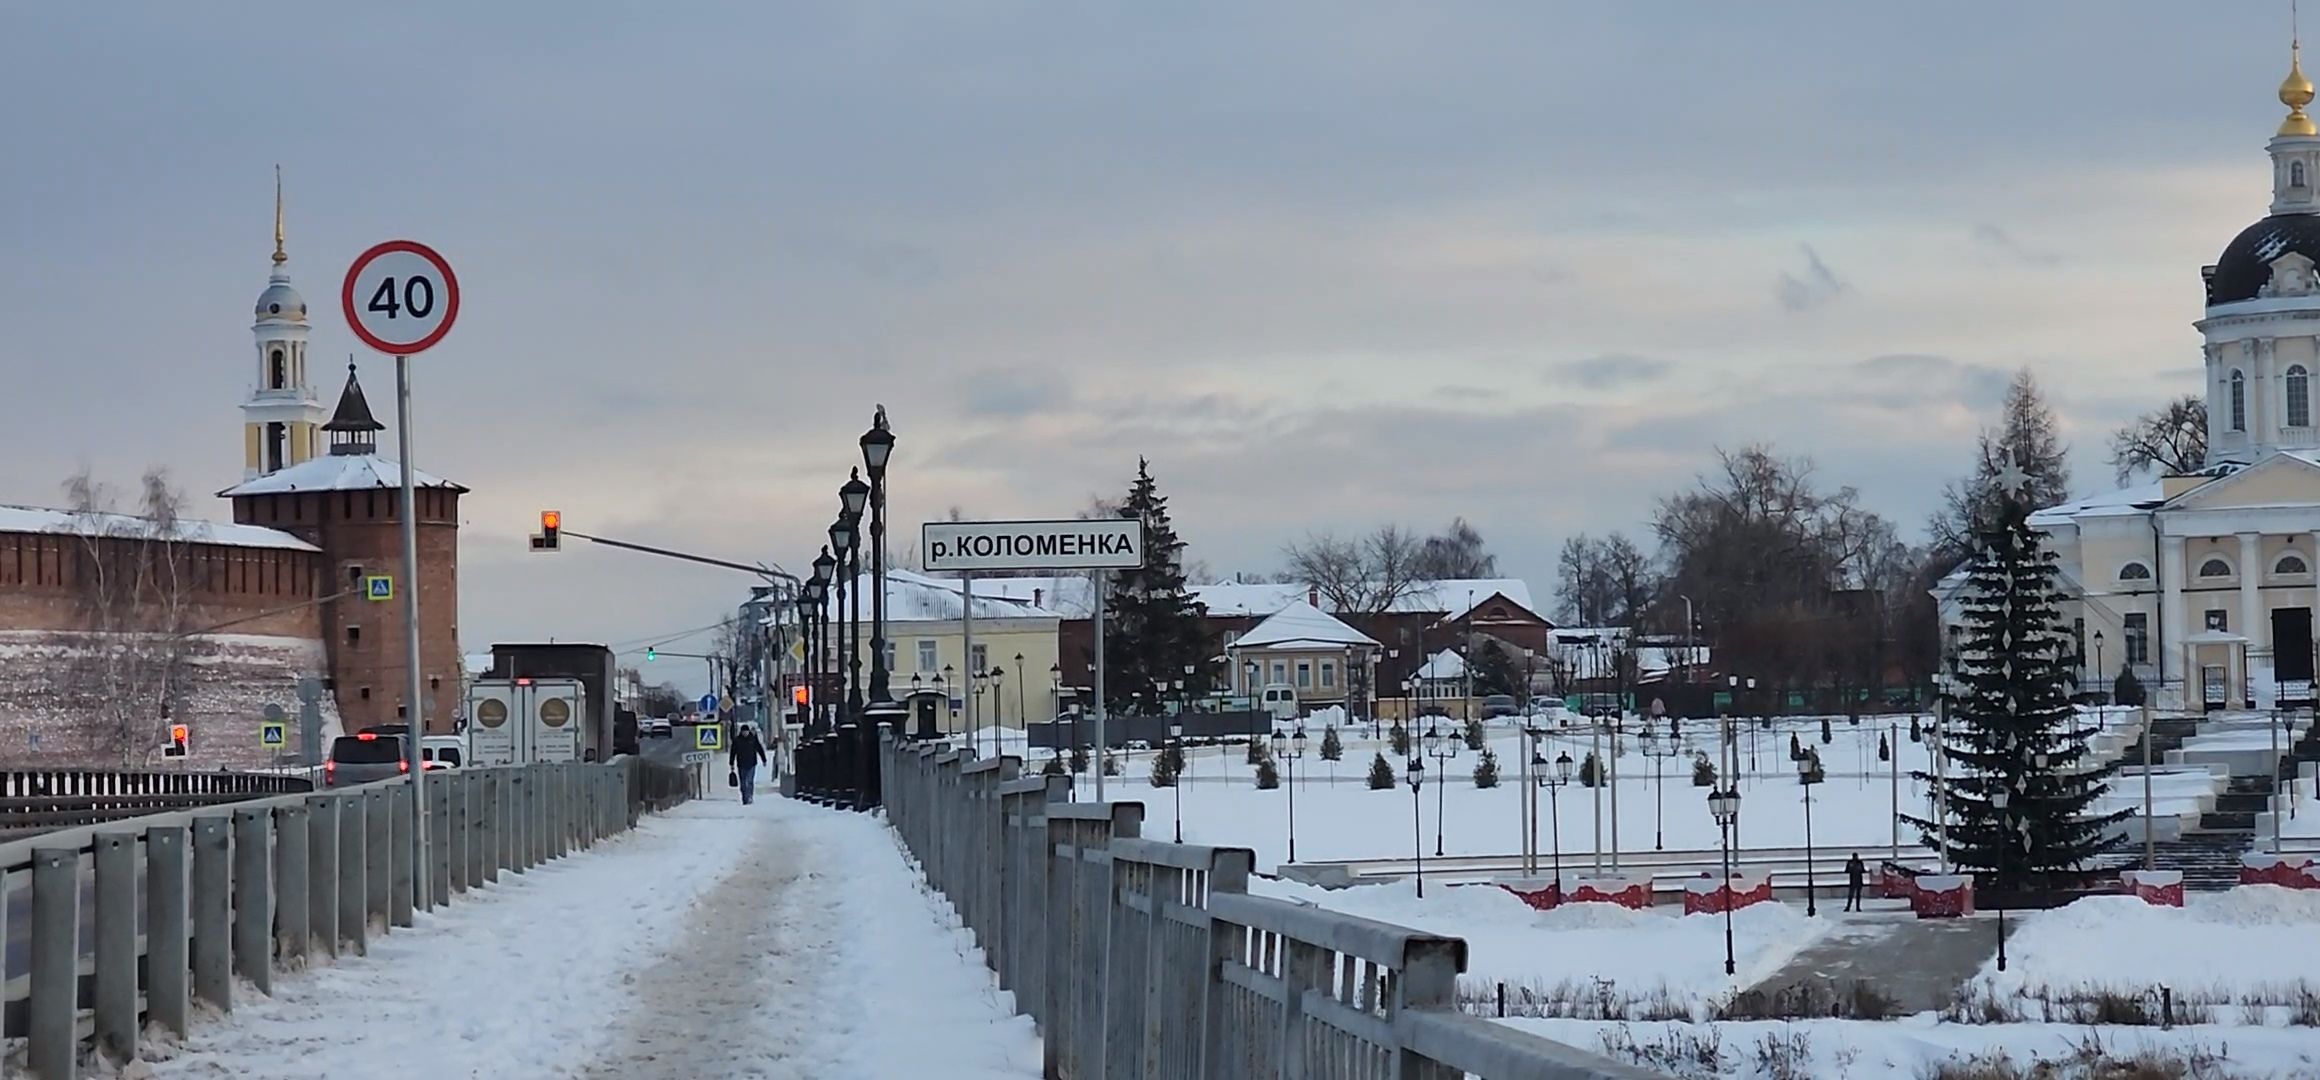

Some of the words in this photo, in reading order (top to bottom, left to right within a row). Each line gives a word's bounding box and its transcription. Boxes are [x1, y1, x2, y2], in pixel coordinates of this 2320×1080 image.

[367, 275, 434, 319] 40
[931, 533, 1134, 562] р.КОЛОМЕНКА
[685, 751, 710, 762] СТОП
